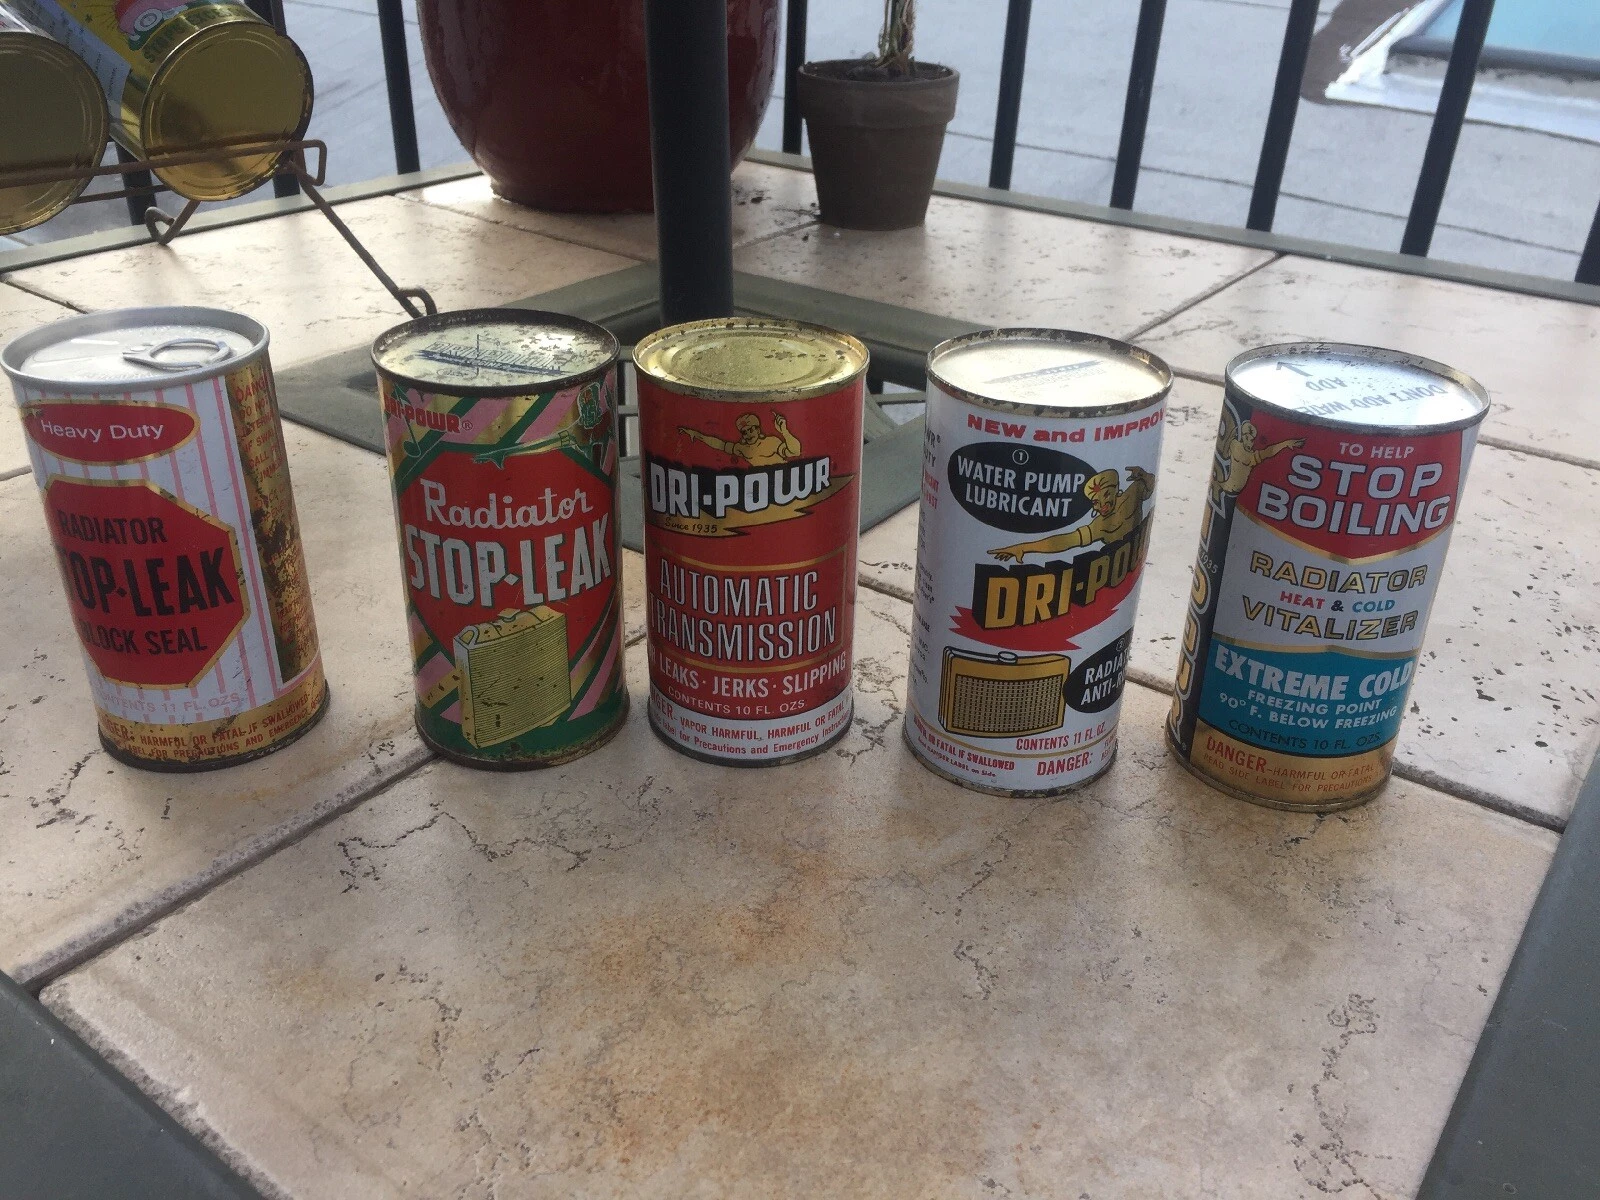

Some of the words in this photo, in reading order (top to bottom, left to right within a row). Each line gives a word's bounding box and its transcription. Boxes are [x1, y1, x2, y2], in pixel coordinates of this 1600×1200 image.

[1306, 376, 1348, 391] ADD
[1350, 394, 1392, 409] ADD
[41, 419, 102, 443] Heavy
[110, 424, 164, 440] Duty
[967, 413, 1027, 439] NEW
[1033, 427, 1086, 443] and
[1339, 441, 1364, 457] TO
[1370, 444, 1415, 460] HELP
[650, 456, 831, 518] DRI-POWR
[957, 455, 1017, 490] WATER
[1024, 469, 1086, 493] PUMP
[1287, 454, 1443, 499] STOP
[420, 478, 594, 530] Radiator
[965, 483, 1073, 518] LUBRICANT
[1256, 483, 1452, 536] BOILING
[57, 509, 168, 545] RADIATOR
[692, 521, 718, 534] 1935
[1250, 550, 1428, 594] RADIATOR
[660, 557, 818, 617] AUTOMATIC
[1280, 591, 1325, 610] HEAT
[1331, 600, 1344, 612] &
[1352, 599, 1396, 613] COLD
[650, 592, 837, 661] TRANSMISSION
[1243, 594, 1419, 641] VITALIZER
[144, 627, 207, 655] SEAL
[660, 652, 699, 690] LEAKS
[712, 675, 769, 698] JERKS
[782, 650, 846, 695] SLIPPING
[1215, 644, 1350, 700] EXTREME
[1358, 660, 1414, 699] COLD
[161, 702, 176, 713] 11
[668, 685, 731, 714] CONTENTS
[736, 705, 751, 715] 10
[1248, 689, 1329, 715] FREEZING
[1335, 698, 1383, 715] POINT
[680, 716, 707, 735] VAPOR
[768, 722, 811, 740] HARMFUL
[815, 715, 826, 727] OR
[1250, 705, 1262, 719] F.
[1269, 710, 1330, 729] BELOW
[1335, 705, 1398, 729] FREEZING
[140, 736, 188, 749] HARMFUL
[192, 734, 207, 746] OR
[245, 733, 264, 747] AND
[694, 736, 747, 754] Precautions
[751, 744, 769, 754] and
[773, 733, 820, 753] Emergency
[1016, 735, 1069, 751] CONTENTS
[1073, 731, 1082, 745] 11
[1228, 719, 1306, 750] CONTENTS
[1313, 739, 1329, 750] 10
[937, 738, 957, 756] FATAL
[959, 749, 966, 759] IF
[967, 752, 1015, 771] SWALLOWED
[1037, 751, 1094, 776] DANGER:
[1256, 776, 1286, 790] LABEL
[1292, 783, 1312, 792] FOR
